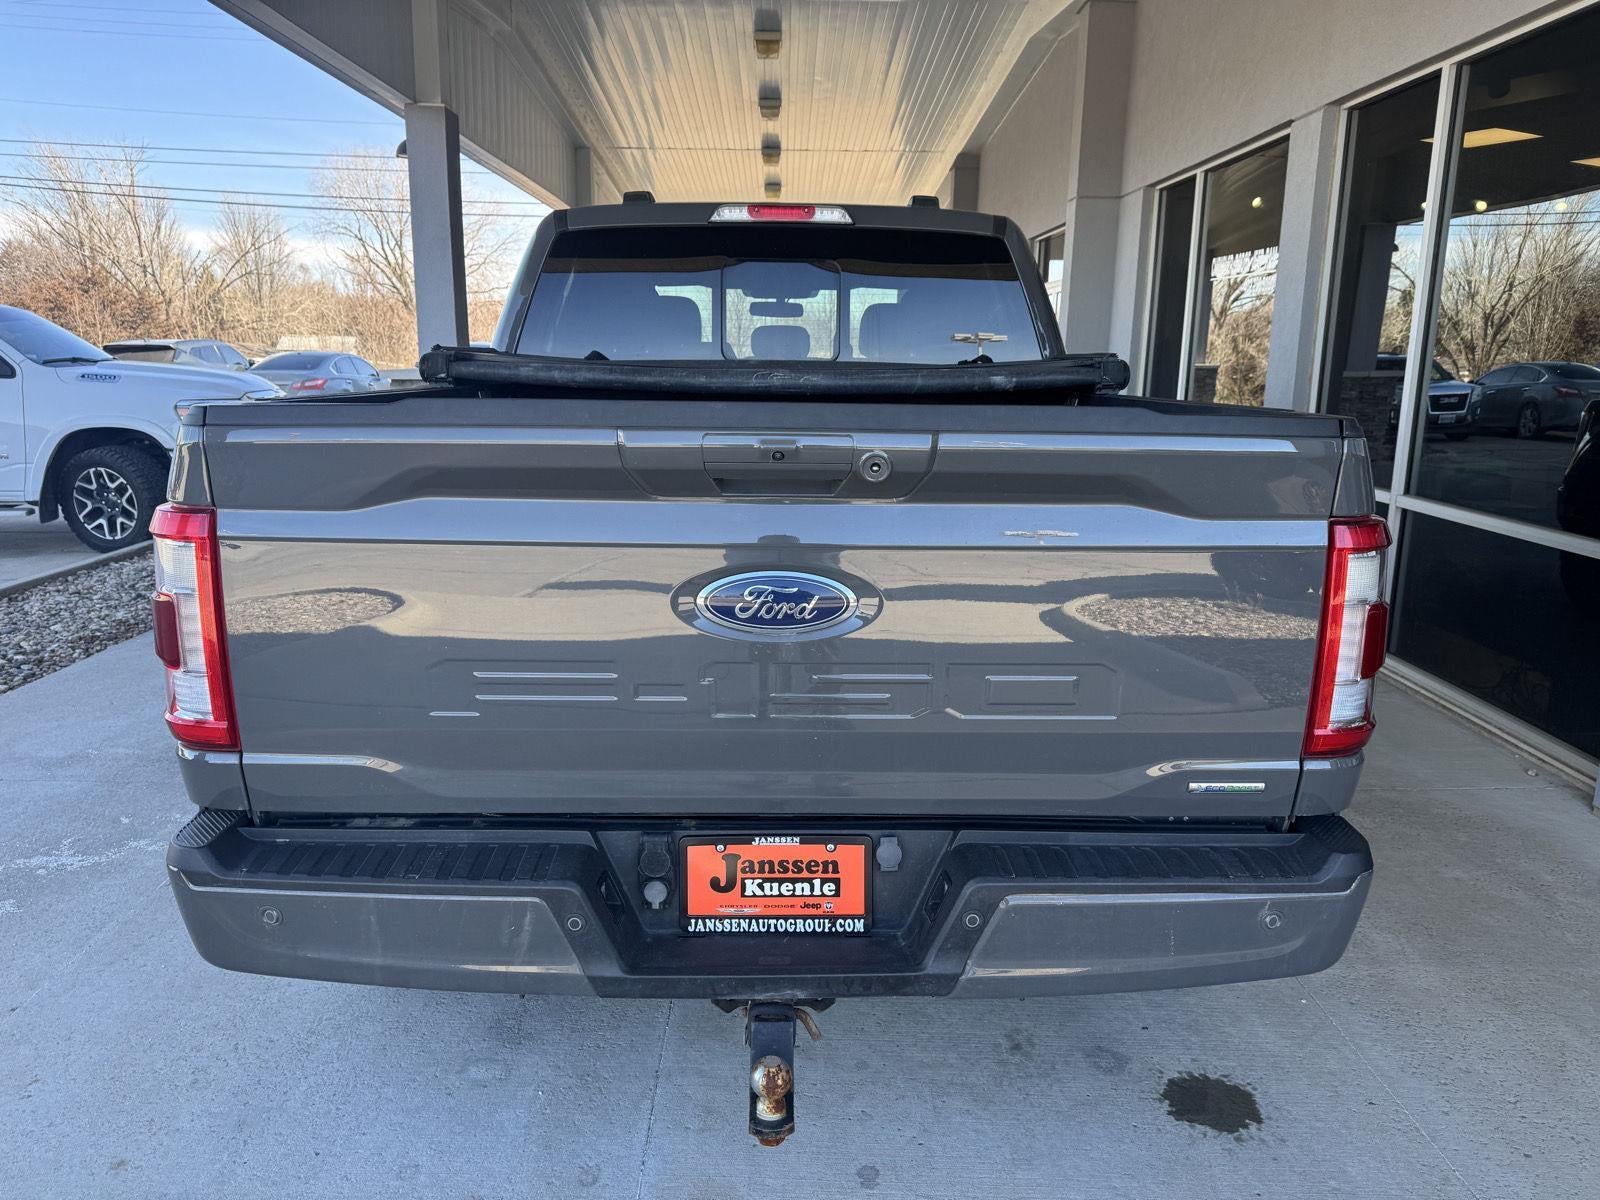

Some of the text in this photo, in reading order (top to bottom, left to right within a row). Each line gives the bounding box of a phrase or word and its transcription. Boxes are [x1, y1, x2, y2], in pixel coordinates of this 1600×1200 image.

[735, 585, 820, 620] Ford
[752, 836, 800, 845] JANSSEN
[709, 853, 840, 893] Janssen
[744, 879, 836, 896] Kuenle
[800, 901, 822, 910] Jeep
